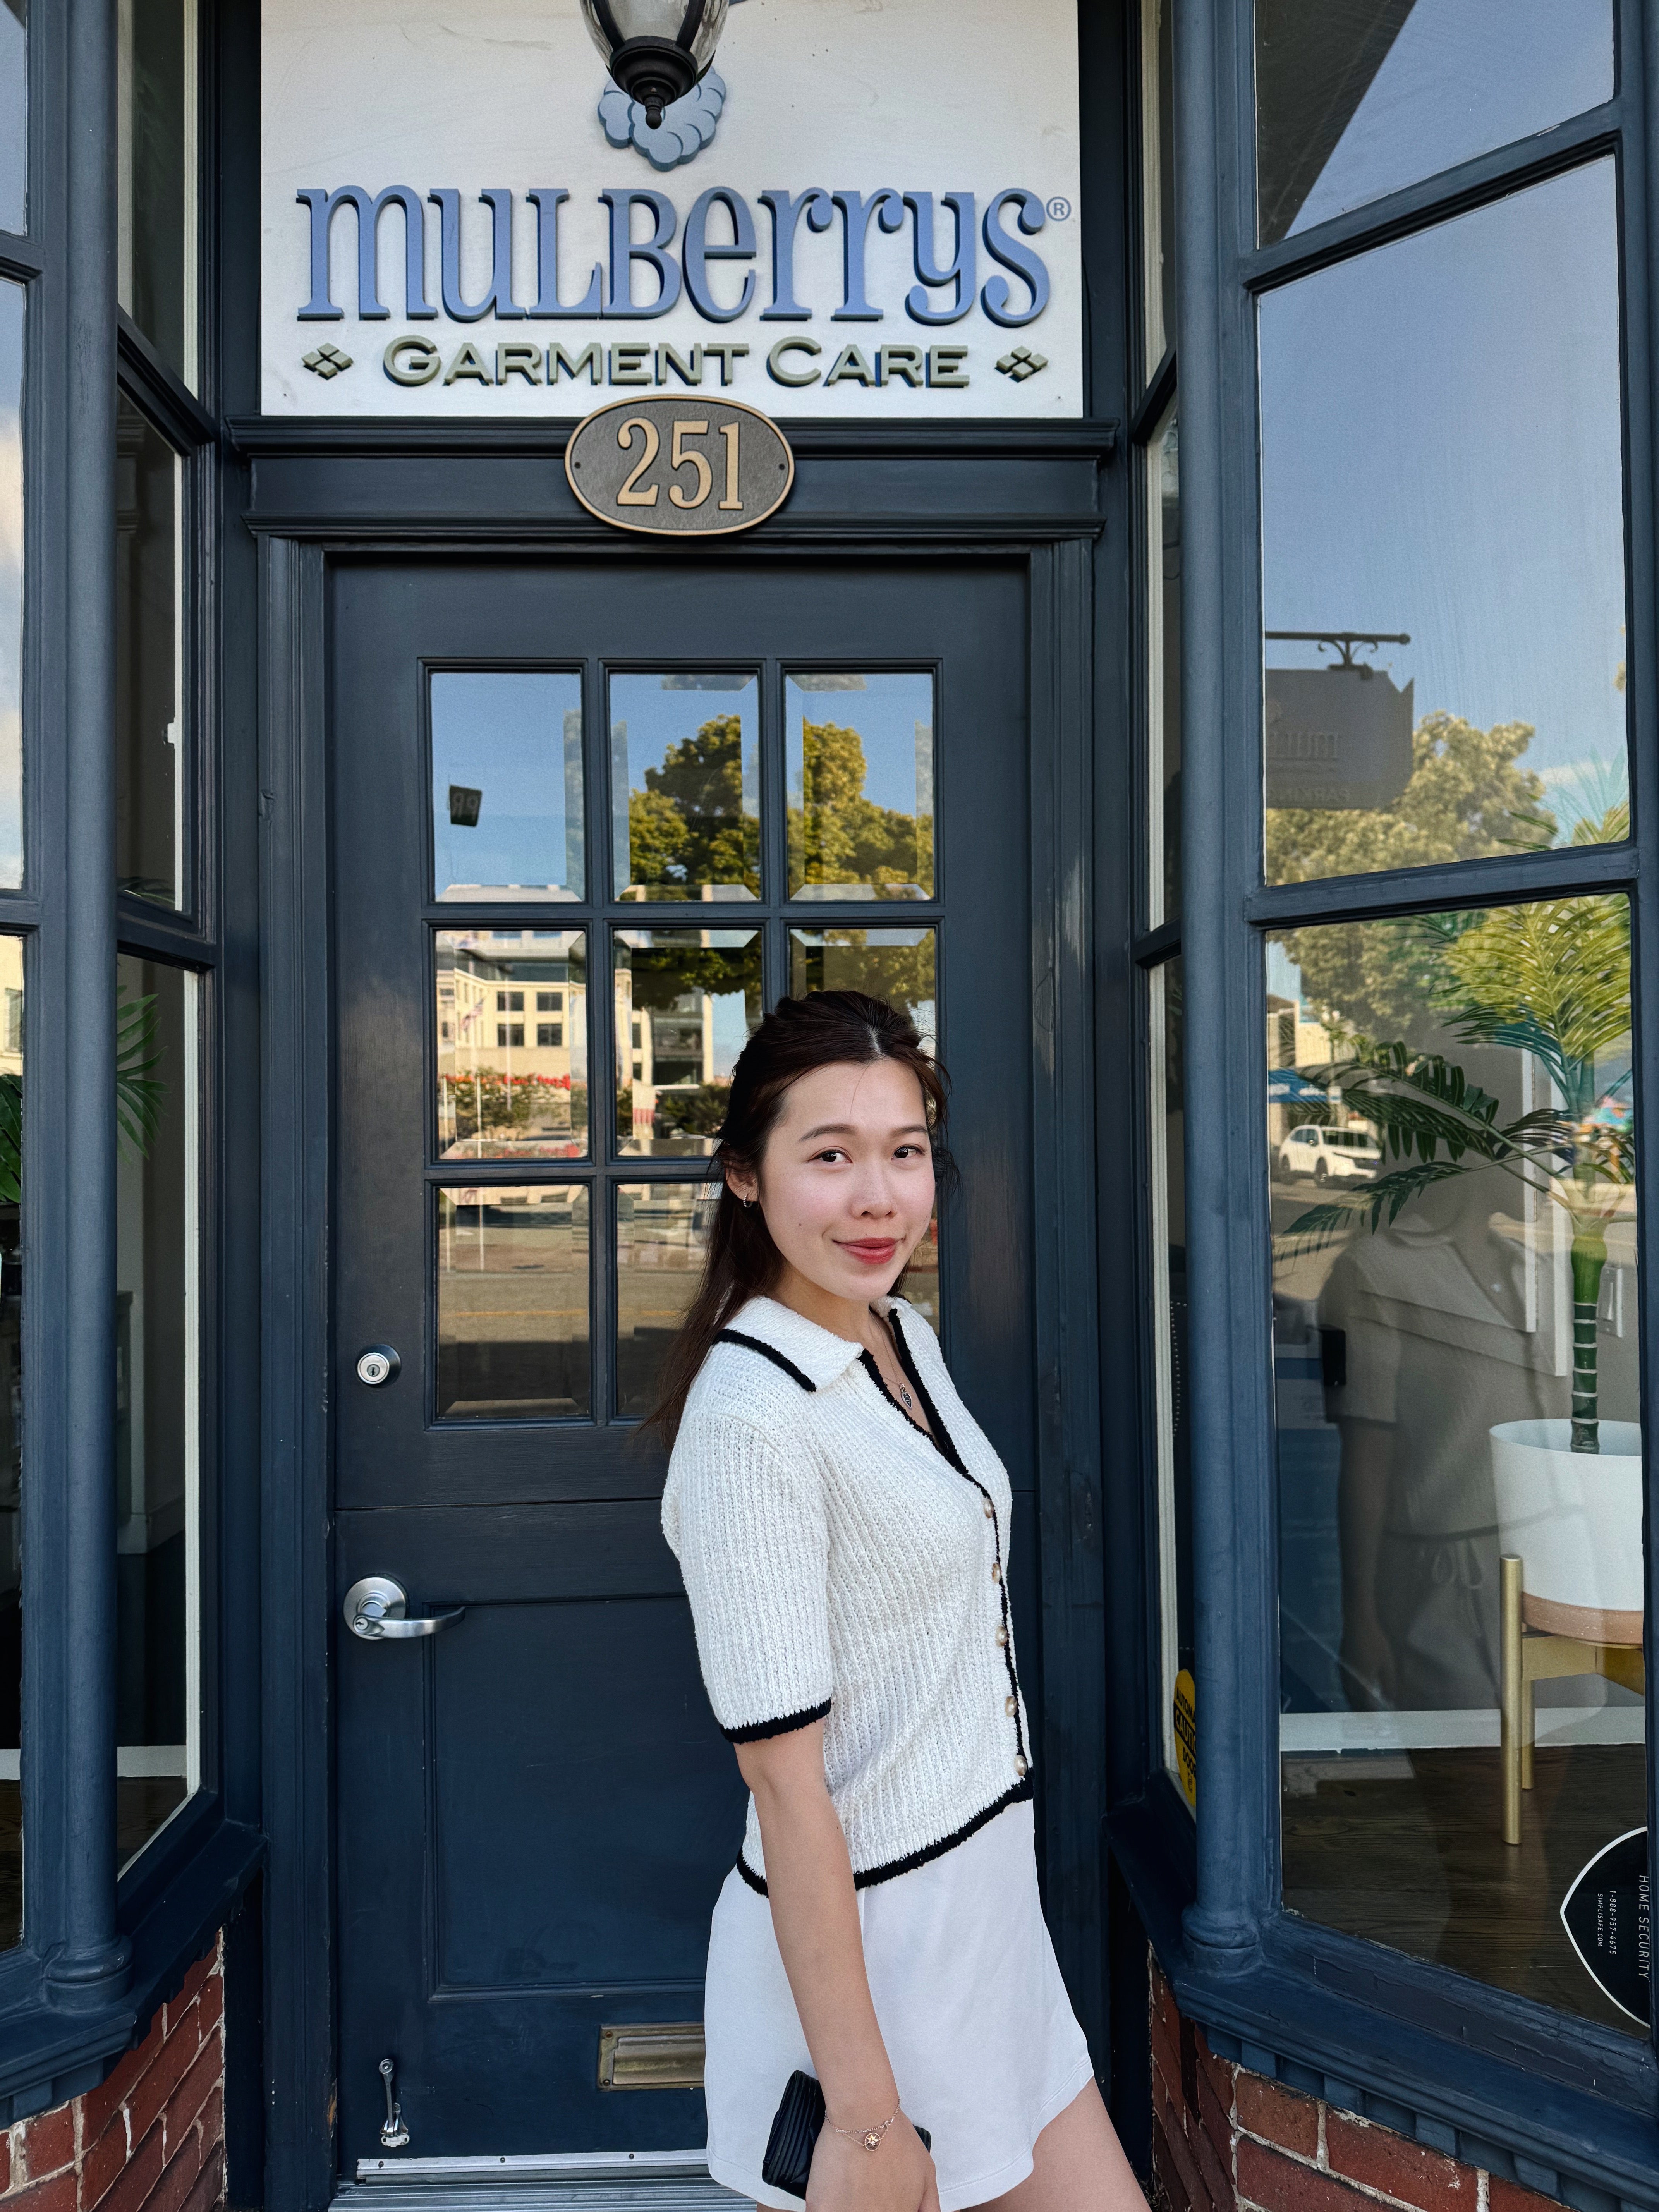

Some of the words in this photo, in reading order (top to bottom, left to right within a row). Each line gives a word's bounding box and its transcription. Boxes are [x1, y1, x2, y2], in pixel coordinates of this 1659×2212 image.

[382, 335, 750, 388] GARMENT
[765, 335, 970, 390] CARE
[617, 418, 743, 509] 251
[1638, 1875, 1650, 1911] HOME
[1638, 1917, 1650, 1980] SECURITY
